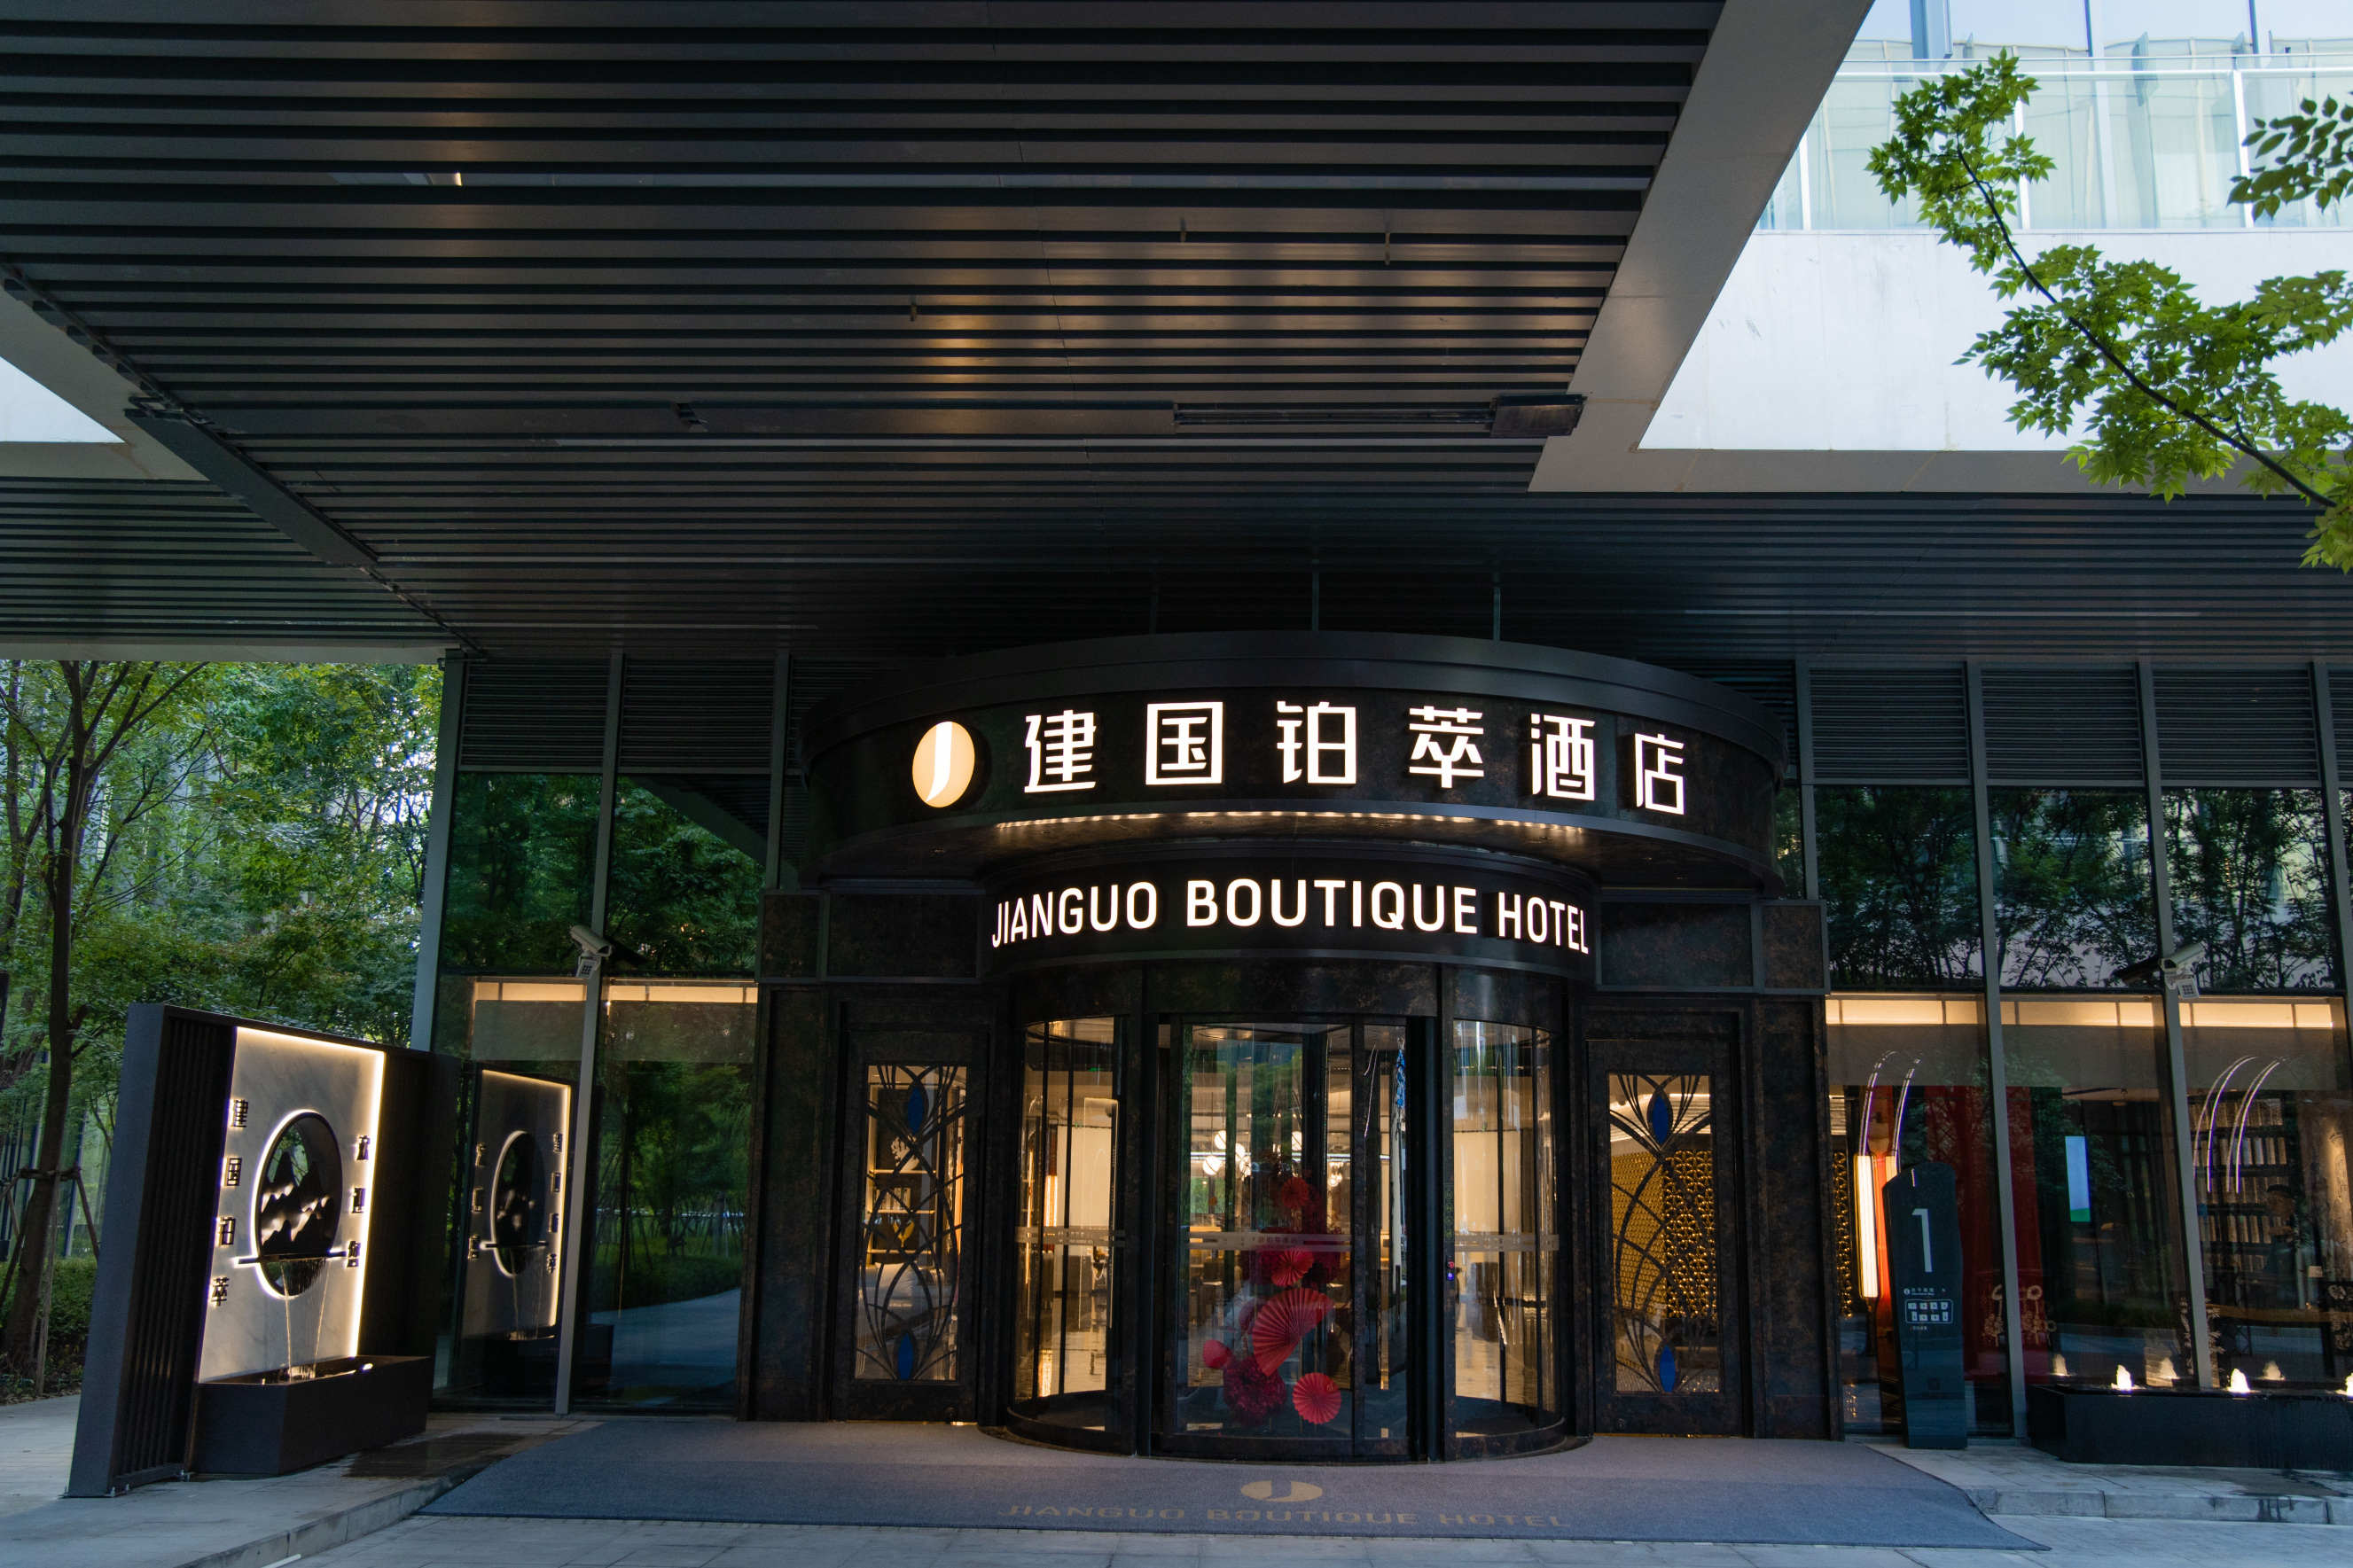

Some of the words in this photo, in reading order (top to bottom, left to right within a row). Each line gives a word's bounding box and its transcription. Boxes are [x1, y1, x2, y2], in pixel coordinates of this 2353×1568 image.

[1024, 700, 1685, 815] 建国铂萃酒店
[992, 881, 1157, 948] JIANGUO
[1186, 878, 1478, 934] BOUTIQUE
[1498, 892, 1589, 955] HOTEL
[1911, 1208, 1932, 1272] 1
[997, 1505, 1185, 1520] JIANGUO
[1206, 1508, 1419, 1525] BOUTIQUE
[1439, 1513, 1571, 1527] HOTEL
